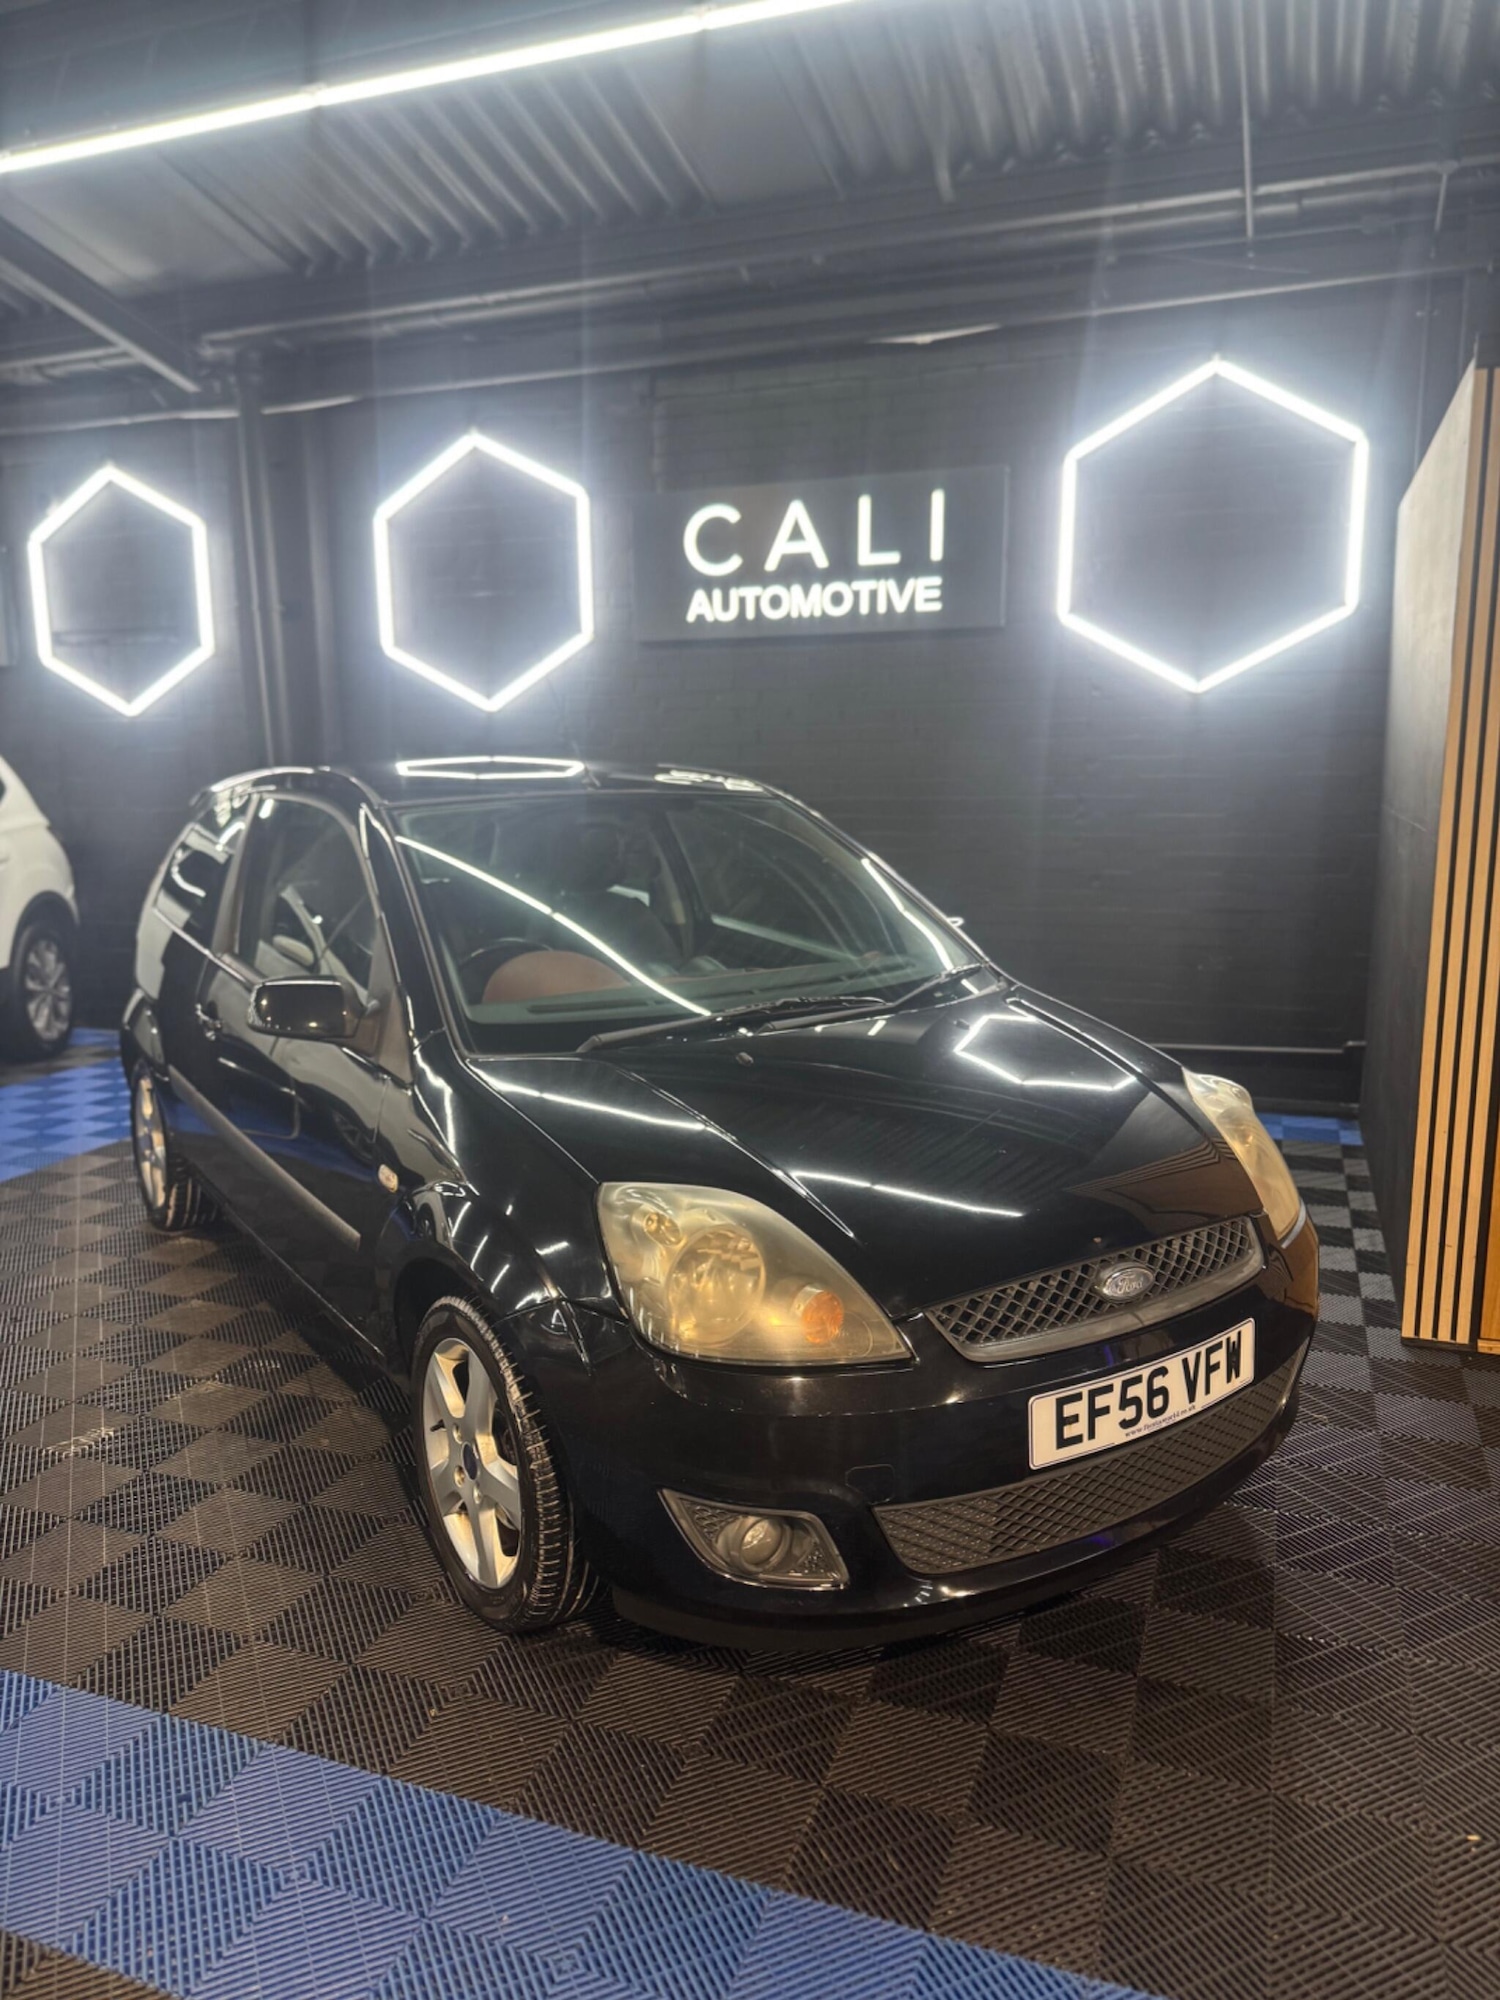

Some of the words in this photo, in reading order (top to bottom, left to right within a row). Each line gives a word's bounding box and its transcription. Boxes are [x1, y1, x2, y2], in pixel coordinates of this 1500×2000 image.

[683, 488, 945, 577] CALI
[686, 576, 942, 623] AUTOMOTIVE
[1055, 1365, 1170, 1451] EF56
[1181, 1330, 1242, 1404] VFW
